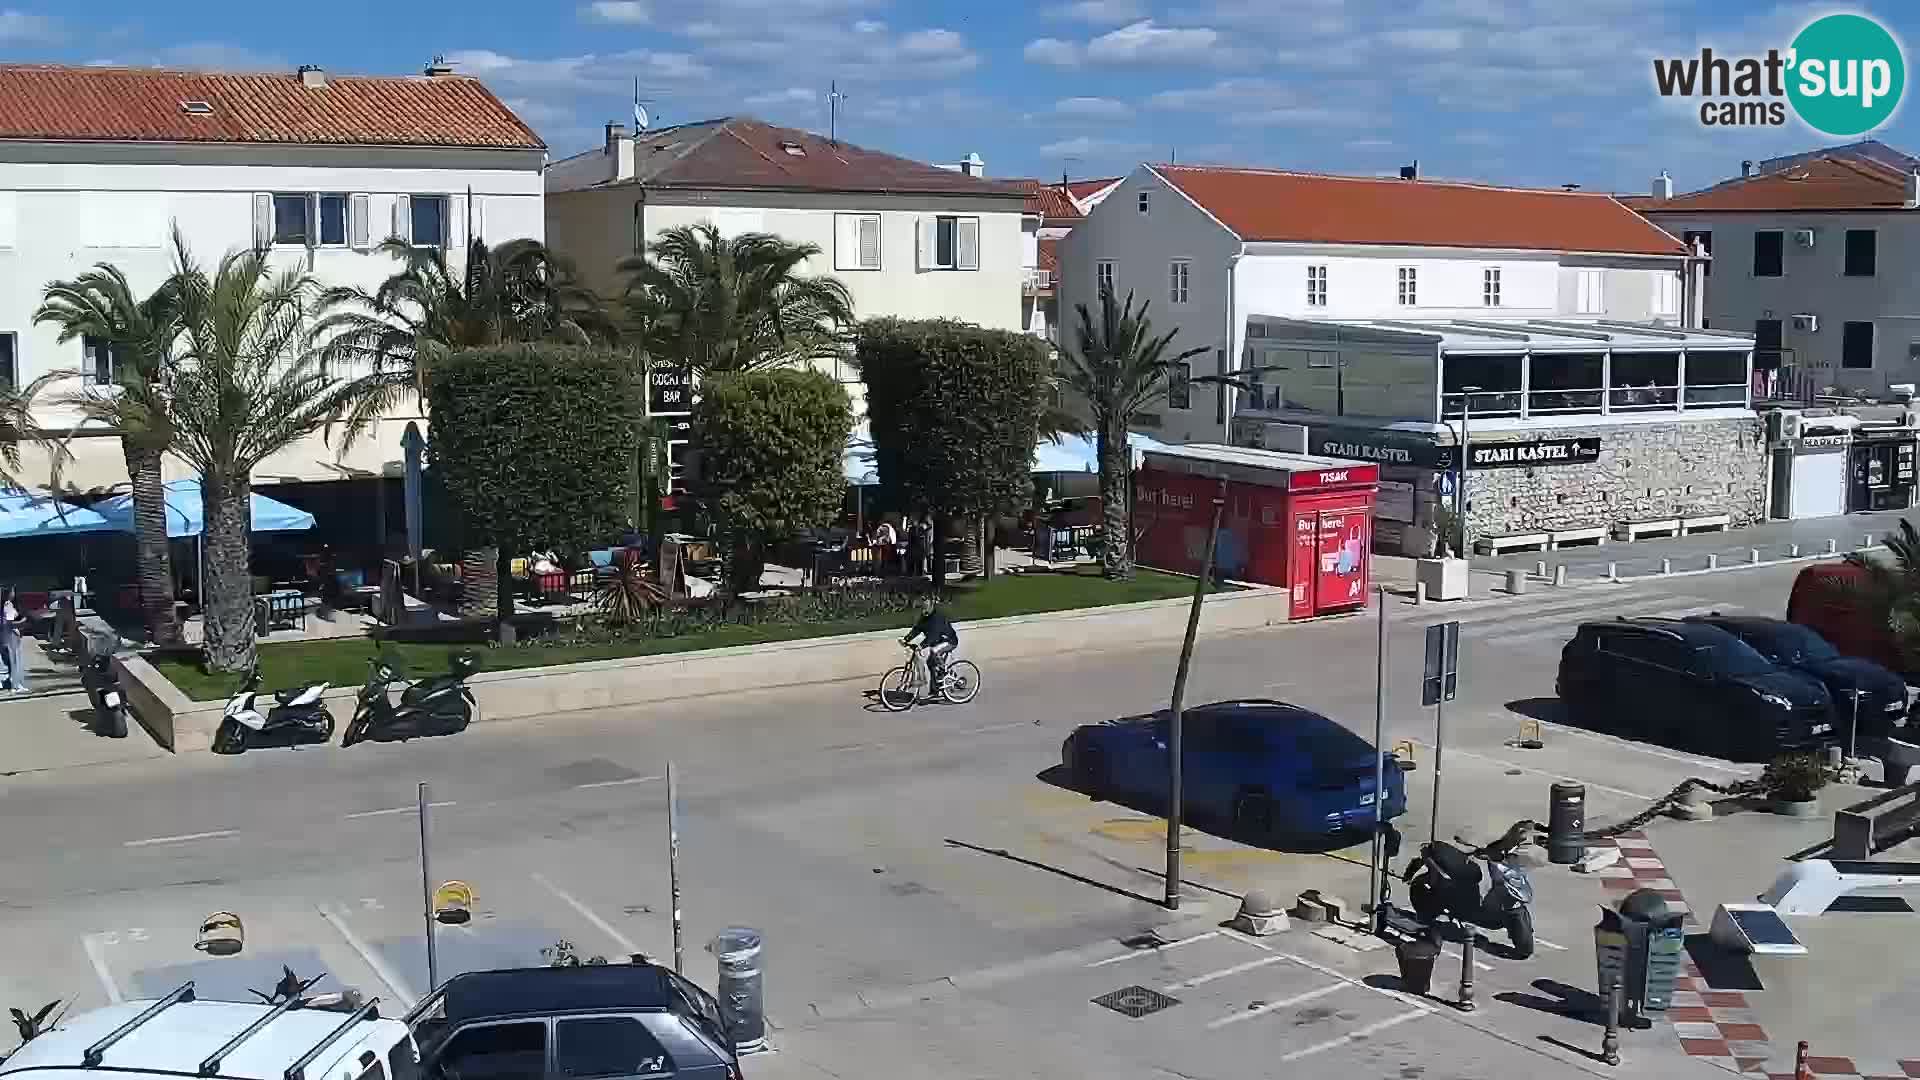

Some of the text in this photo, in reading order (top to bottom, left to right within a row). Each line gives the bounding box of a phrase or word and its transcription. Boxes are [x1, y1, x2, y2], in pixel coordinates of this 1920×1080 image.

[663, 390, 681, 403] BAR
[1323, 442, 1412, 461] STARI KAŠTEL
[1474, 447, 1515, 463] STARI
[1517, 443, 1569, 461] KAŠTEL
[1319, 470, 1349, 483] TISAK
[1298, 516, 1345, 532] Buy here!
